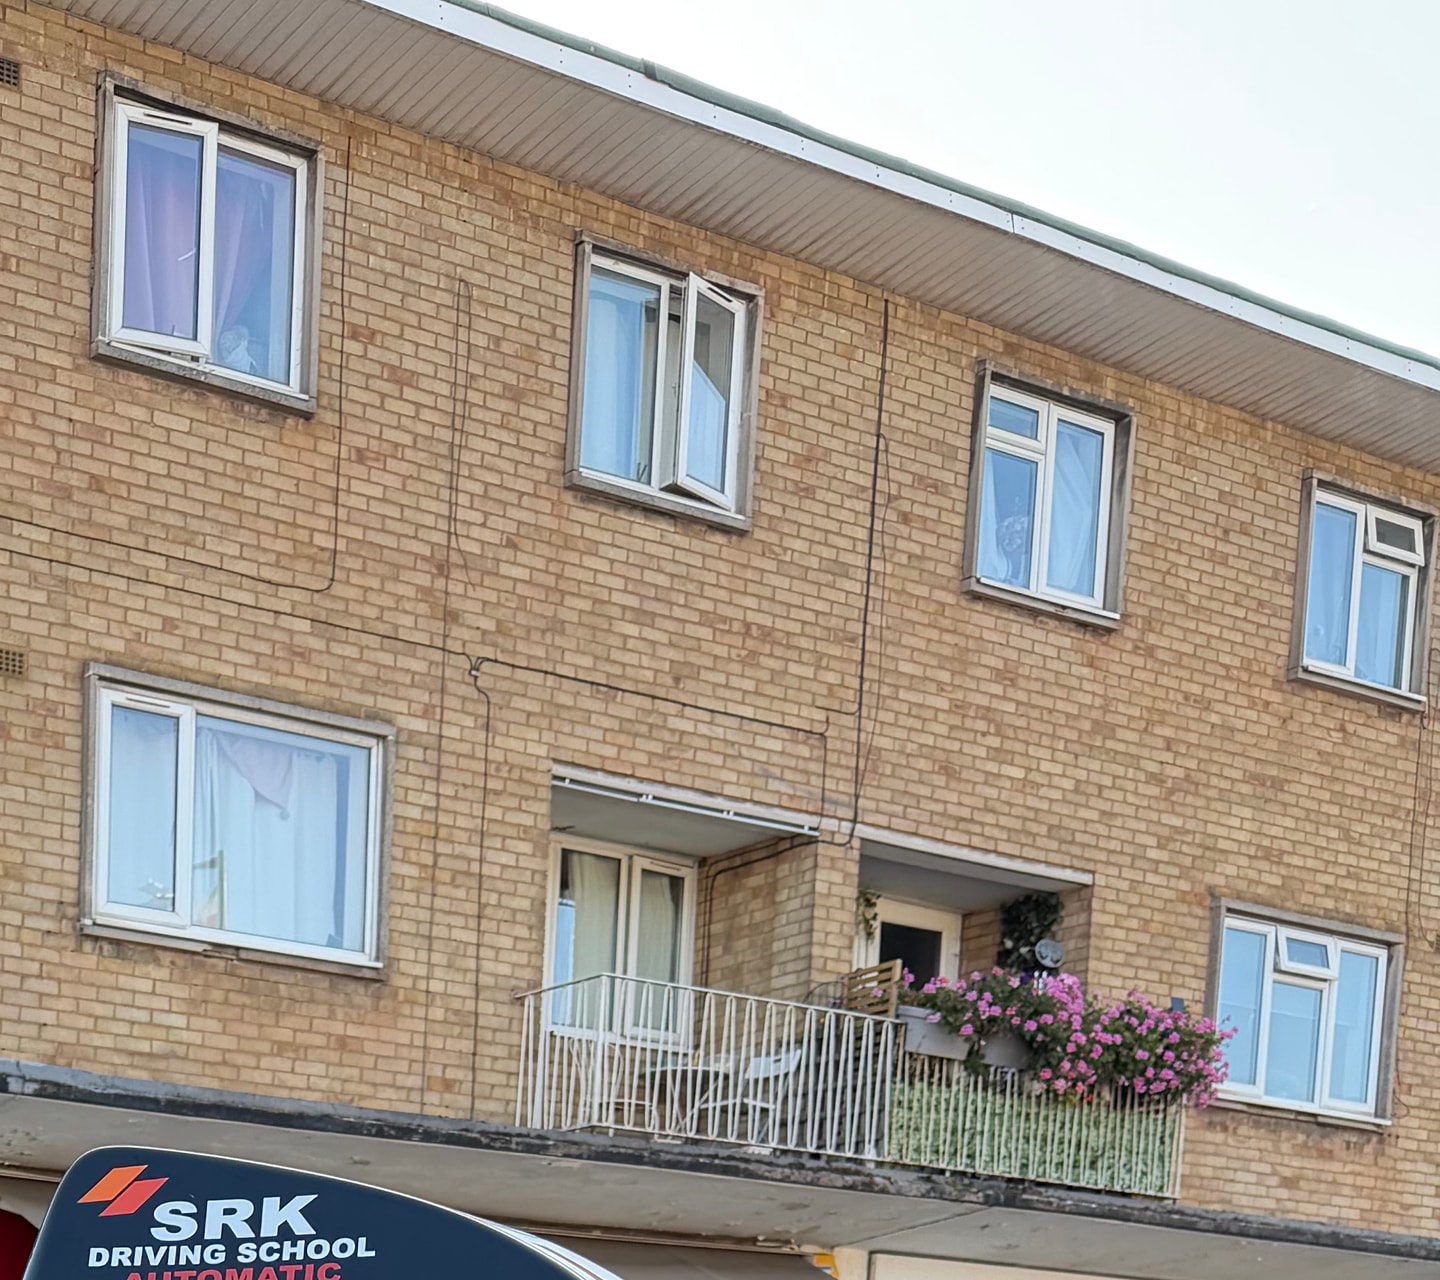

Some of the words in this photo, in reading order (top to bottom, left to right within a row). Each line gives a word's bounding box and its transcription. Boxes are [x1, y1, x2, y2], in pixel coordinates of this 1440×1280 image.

[150, 1194, 319, 1242] SRK
[88, 1244, 228, 1267] DRIVING
[236, 1237, 376, 1263] SCHOOL
